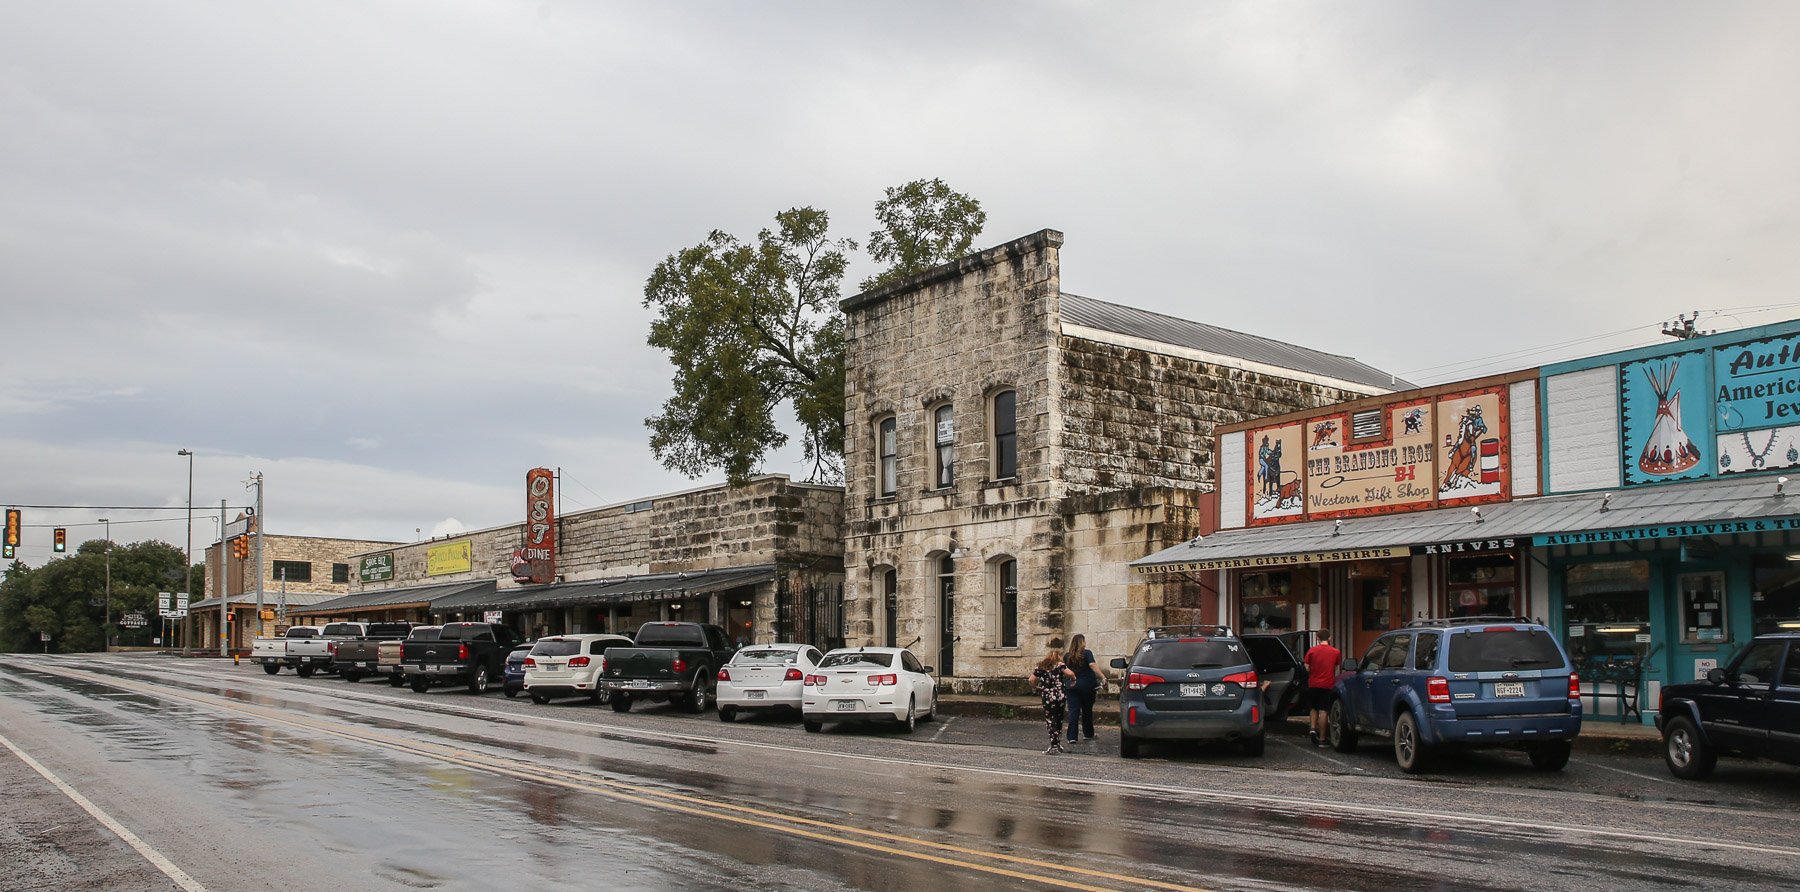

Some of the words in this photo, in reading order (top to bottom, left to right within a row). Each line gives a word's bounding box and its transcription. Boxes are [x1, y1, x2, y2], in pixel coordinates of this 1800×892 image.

[1308, 457, 1330, 477] THE
[1335, 448, 1398, 473] BRANDING
[1402, 443, 1433, 465] IRON
[1309, 493, 1361, 507] Western
[1364, 486, 1392, 502] Gift
[1397, 483, 1430, 499] Shop
[1547, 528, 1659, 545] AUTHENTIC
[1667, 522, 1749, 536] SILVER
[1754, 521, 1765, 530] &
[1425, 539, 1515, 554] KNIVES
[1137, 564, 1184, 573] UNIQUE
[1188, 559, 1250, 570] WESTERN
[1256, 555, 1298, 566] GIFTS
[1317, 548, 1391, 561] T-SHIRTS
